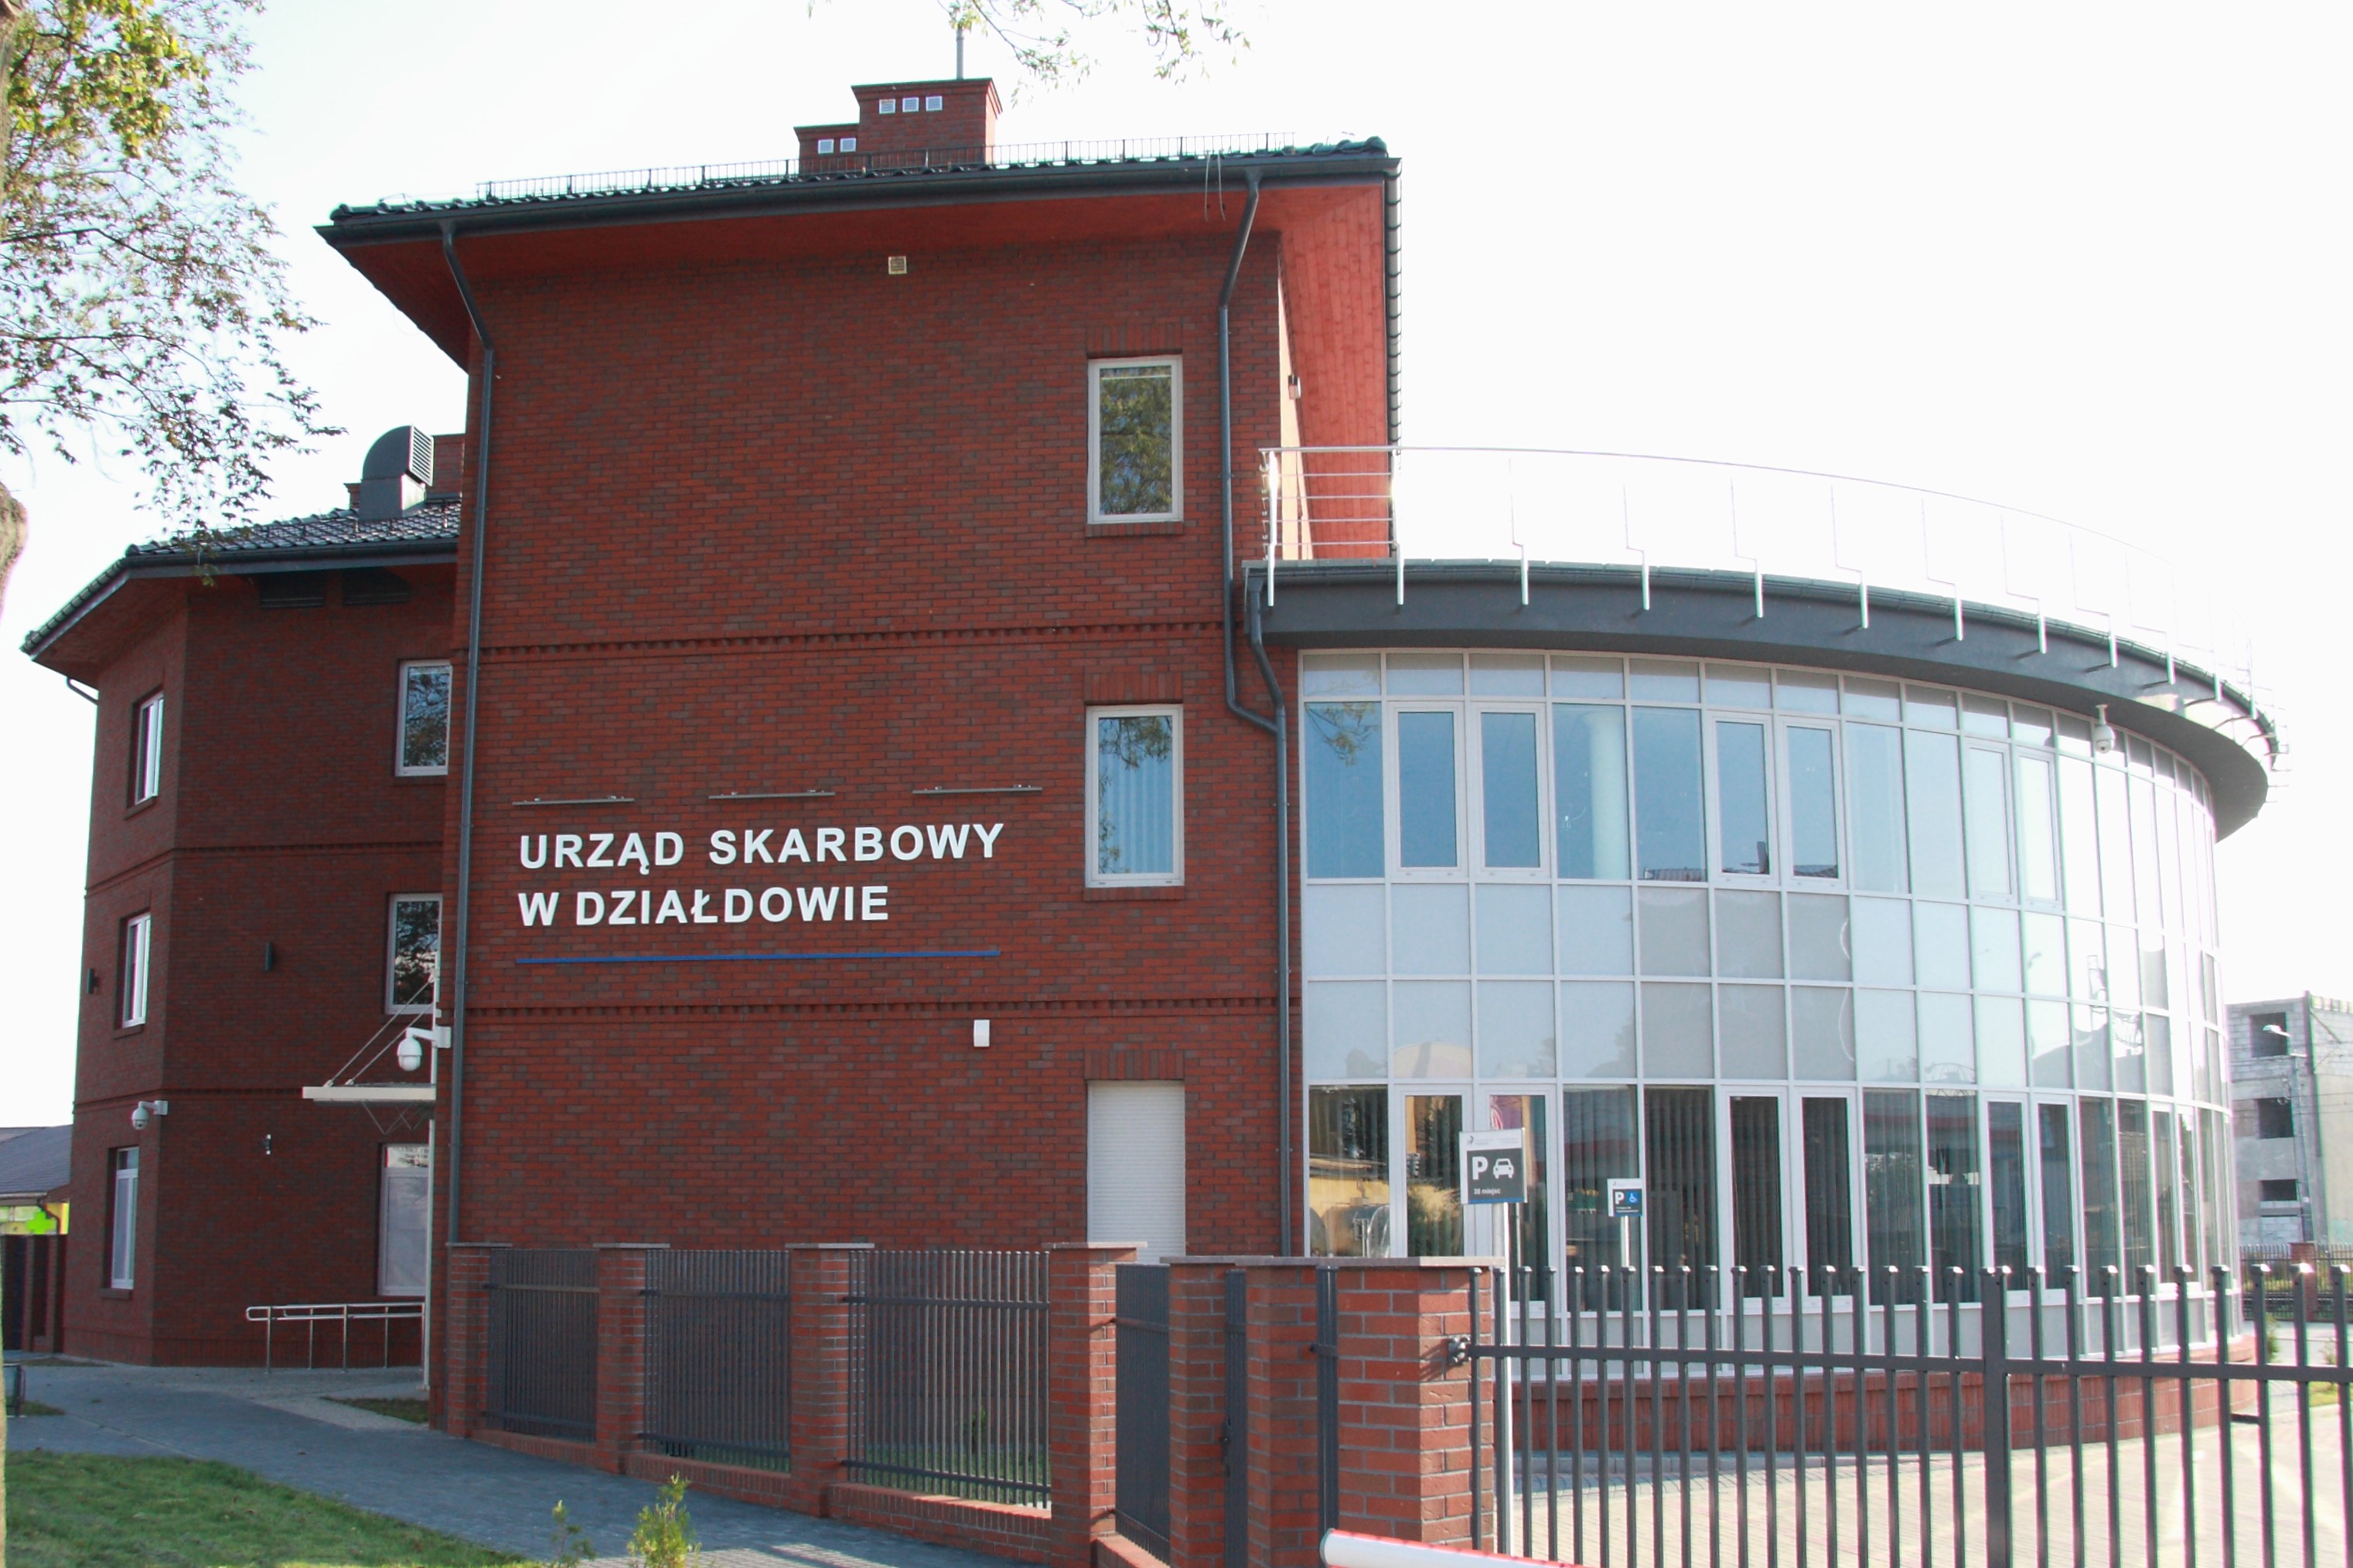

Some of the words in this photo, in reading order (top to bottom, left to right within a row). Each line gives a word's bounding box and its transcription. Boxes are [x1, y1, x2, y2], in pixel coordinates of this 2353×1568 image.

[520, 831, 684, 875] URZĄD
[709, 823, 1004, 865] SKARBOWY
[517, 891, 560, 926] W
[575, 885, 889, 926] DZIAŁDOWIE
[1471, 1156, 1489, 1181] P
[1615, 1191, 1625, 1205] P
